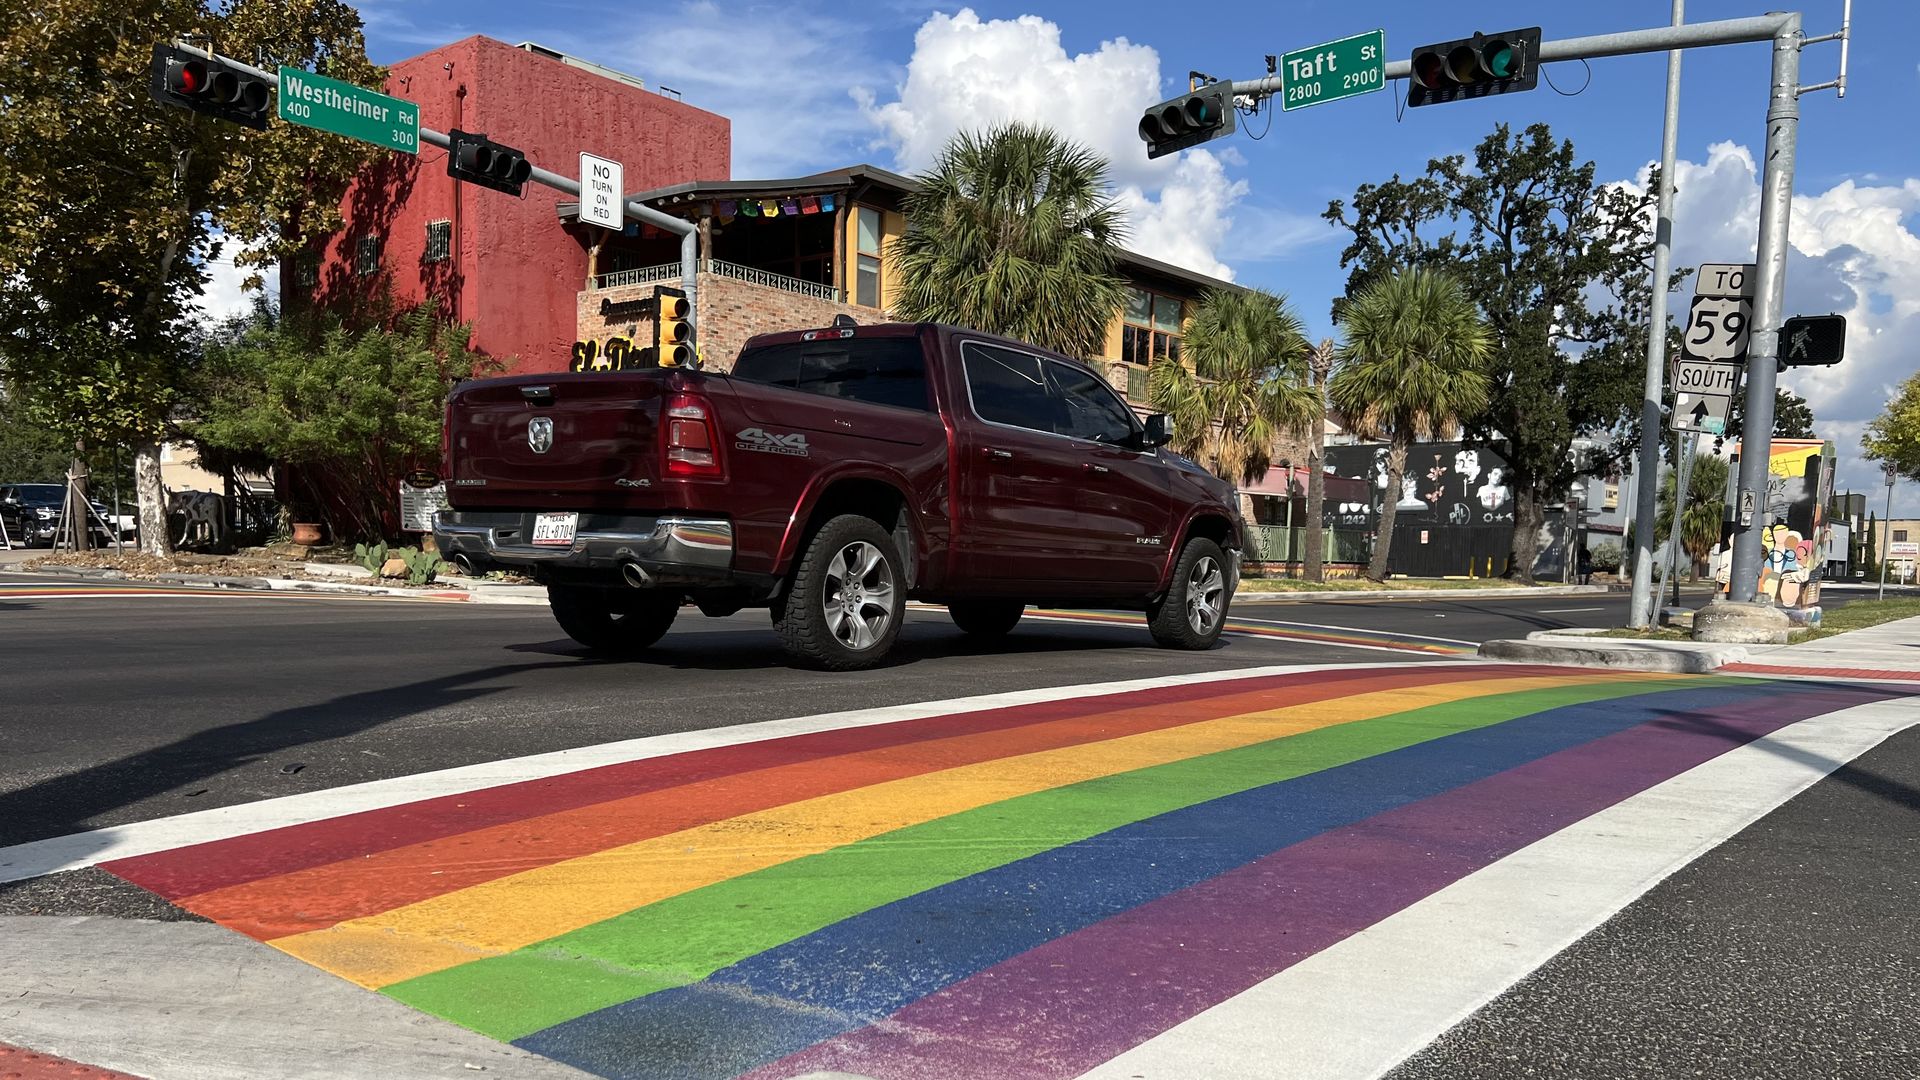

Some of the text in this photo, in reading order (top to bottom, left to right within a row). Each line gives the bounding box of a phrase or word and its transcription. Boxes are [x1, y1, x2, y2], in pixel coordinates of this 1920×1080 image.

[1287, 44, 1376, 81] Taft St
[1289, 68, 1377, 102] 2800 2900
[286, 75, 414, 126] Westheimer Rd
[287, 101, 413, 146] 400 300
[593, 163, 610, 179] NO
[591, 179, 613, 194] TURN
[596, 194, 608, 206] ON
[593, 206, 610, 219] RED
[1715, 271, 1745, 290] TO
[1690, 310, 1746, 347] 59
[1680, 367, 1737, 389] SOUTH
